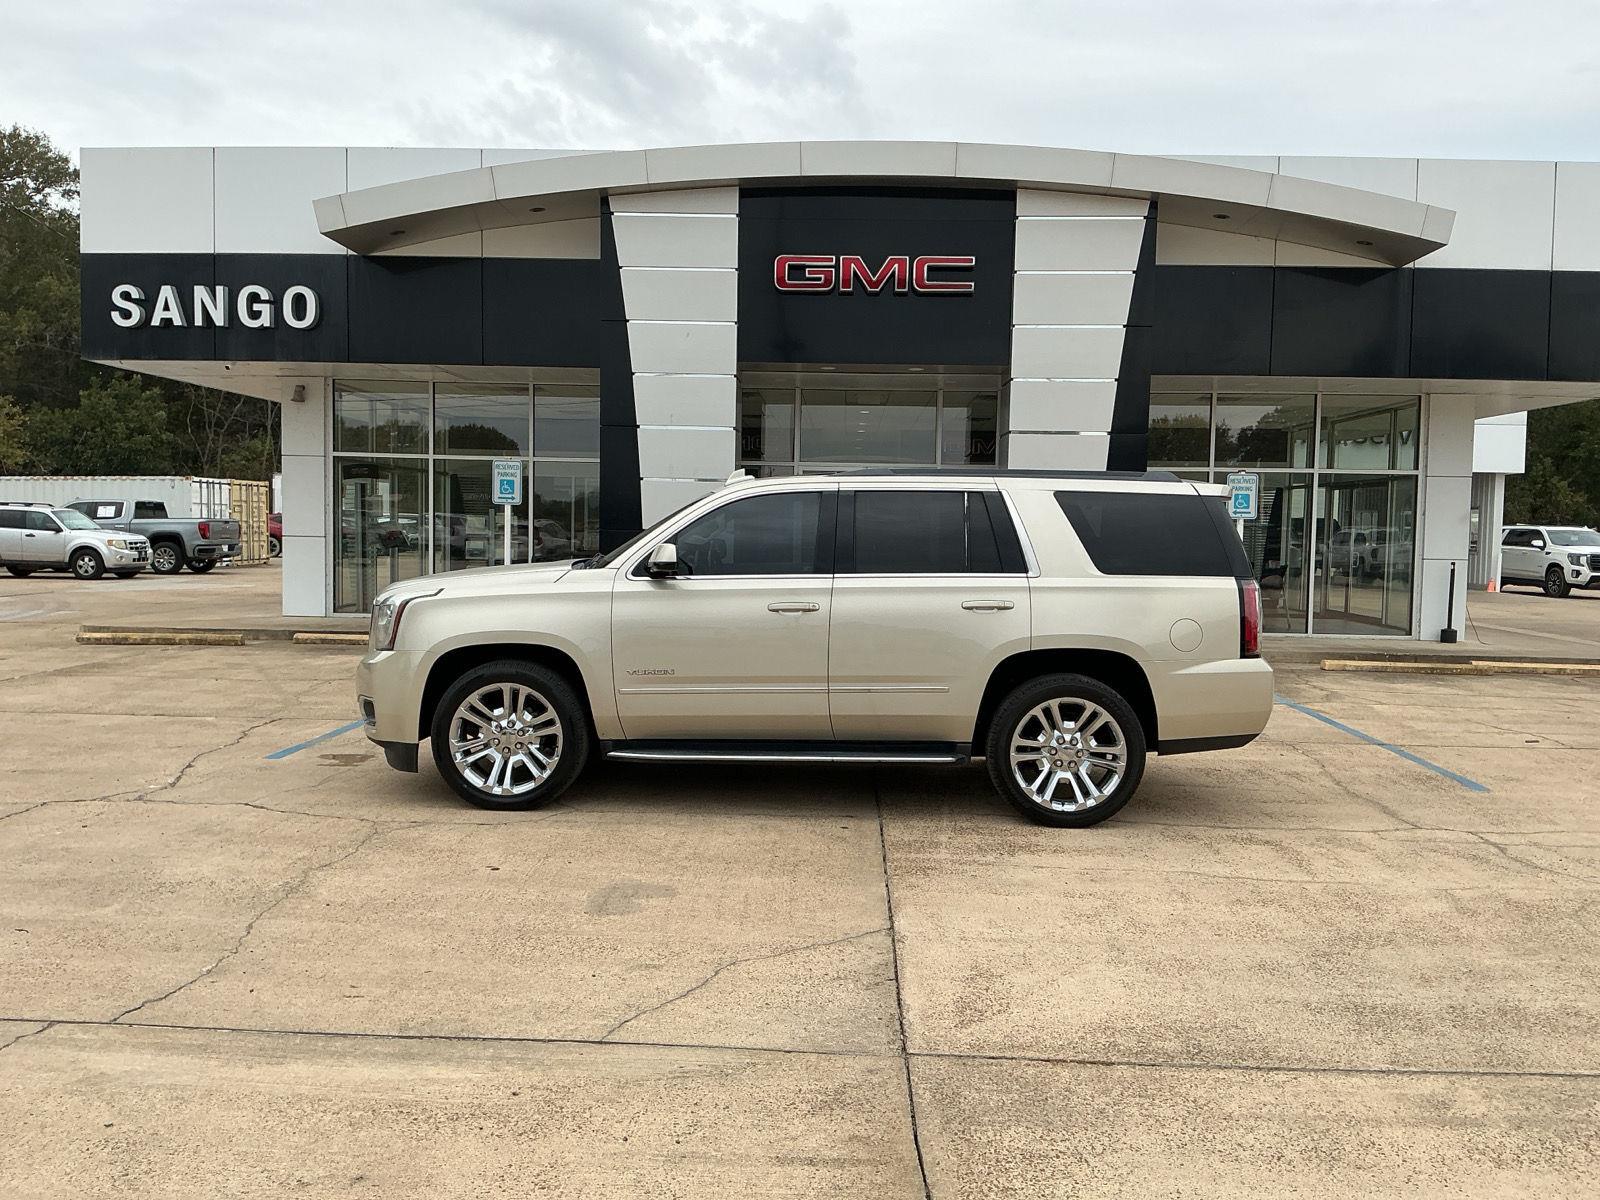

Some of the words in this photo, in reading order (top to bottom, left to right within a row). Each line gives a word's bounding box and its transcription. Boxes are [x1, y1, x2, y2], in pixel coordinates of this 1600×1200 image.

[774, 254, 976, 294] GMC
[110, 283, 320, 330] SANGO
[625, 668, 675, 676] YUKON
